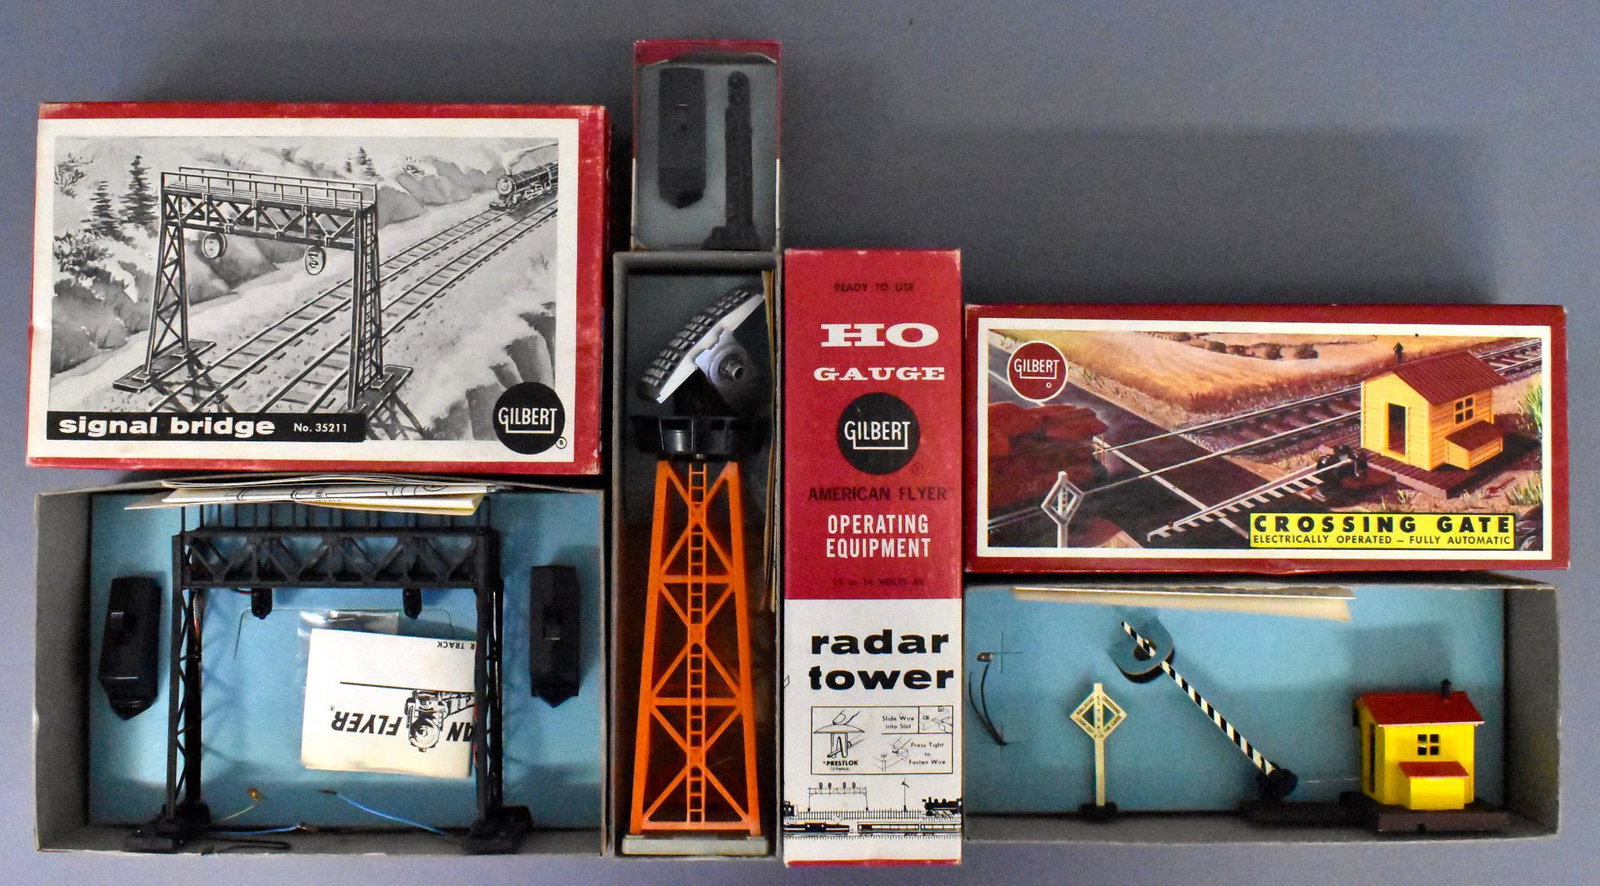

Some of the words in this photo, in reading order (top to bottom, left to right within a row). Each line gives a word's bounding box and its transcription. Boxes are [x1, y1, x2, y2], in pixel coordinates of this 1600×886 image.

[833, 283, 868, 292] READY
[875, 283, 889, 292] TO
[895, 283, 915, 292] USE
[820, 322, 940, 348] HO
[813, 366, 946, 382] GAUGE
[1013, 358, 1060, 379] GILBERT
[58, 416, 158, 437] signal
[169, 416, 276, 438] bridge
[293, 422, 312, 433] No.
[315, 422, 348, 433] 35211
[498, 406, 558, 434] GILBERT
[843, 420, 911, 450] GILBERT
[807, 486, 891, 501] AMERICAN
[899, 486, 947, 501] FLYER
[827, 513, 930, 535] OPERATING
[1253, 514, 1417, 534] CROSSING
[1436, 515, 1511, 534] GATE
[826, 538, 932, 559] EQUIPMENT
[1253, 534, 1330, 544] ELECTRICALLY
[1336, 535, 1392, 545] OPERATED
[1409, 535, 1441, 545] FULLY
[1447, 535, 1511, 545] AUTOMATIC
[879, 578, 907, 586] VOLTS
[436, 640, 465, 650] TRACK
[811, 629, 950, 655] radar
[808, 665, 955, 691] tower
[331, 711, 403, 737] FLYER
